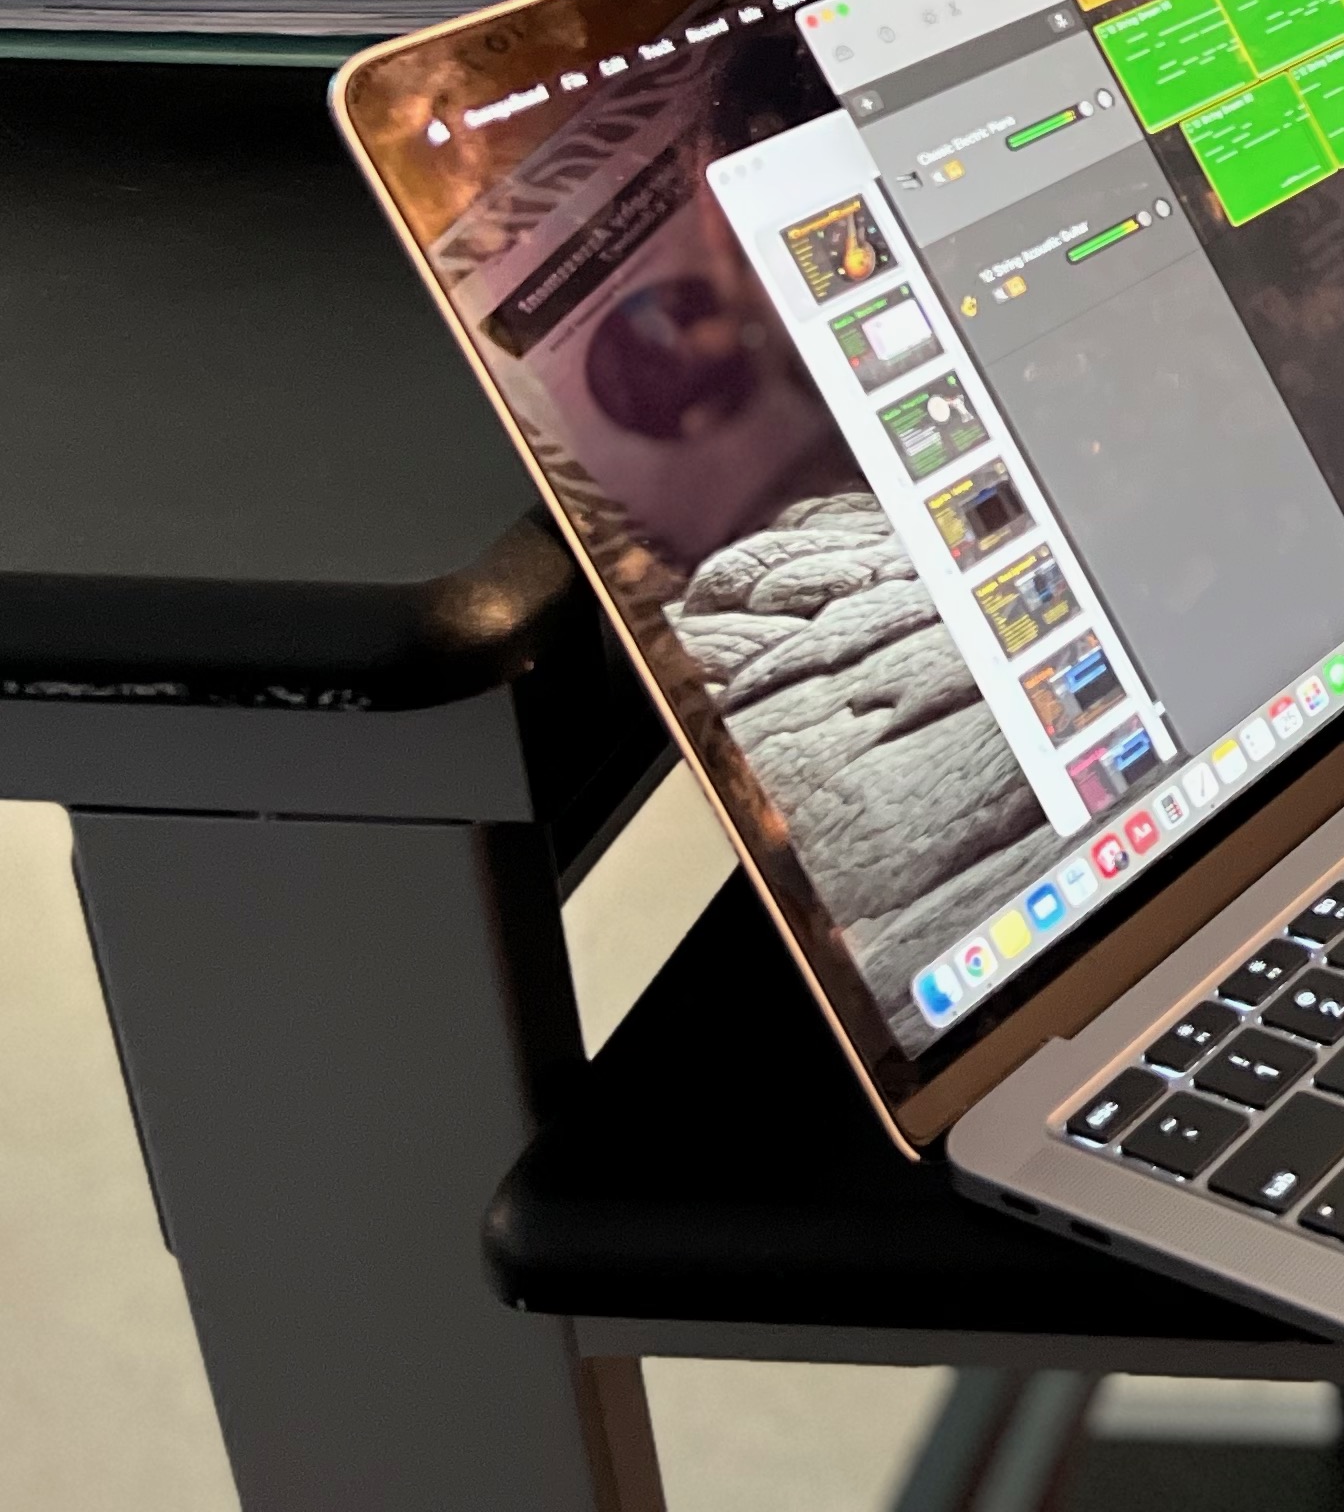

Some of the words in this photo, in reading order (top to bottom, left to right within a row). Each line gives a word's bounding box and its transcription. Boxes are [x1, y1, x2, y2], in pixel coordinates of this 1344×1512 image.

[1254, 1064, 1280, 1077] 1
[1086, 1101, 1119, 1127] esc
[1263, 1172, 1296, 1198] tab
